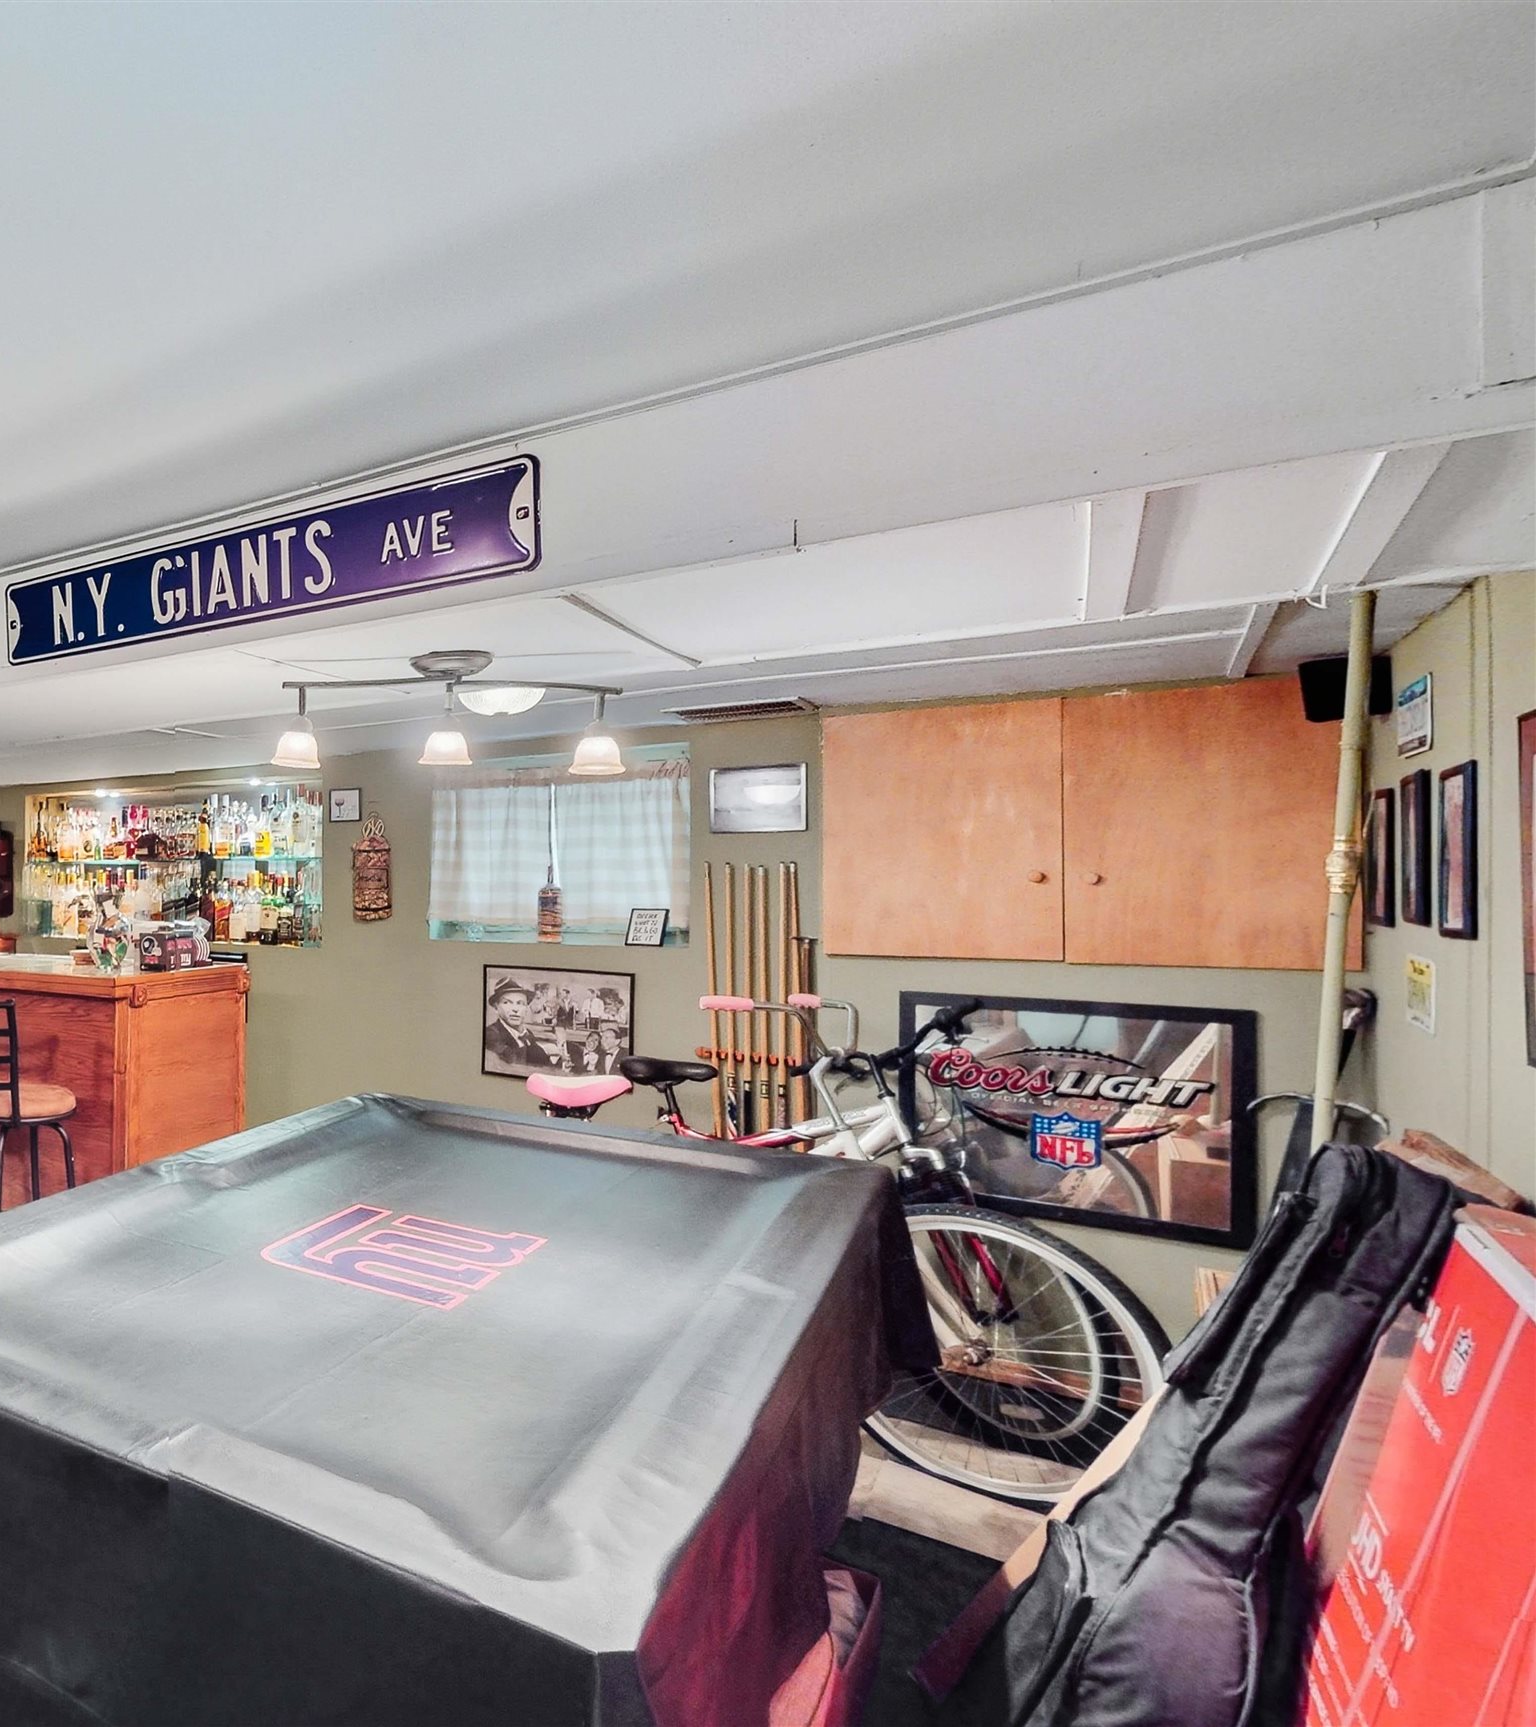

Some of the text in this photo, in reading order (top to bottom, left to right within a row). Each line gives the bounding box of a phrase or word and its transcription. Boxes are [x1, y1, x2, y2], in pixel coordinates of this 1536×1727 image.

[51, 509, 455, 646] N.Y. GIANTS AVE
[927, 1047, 1214, 1108] Coors LIGHT
[1036, 1134, 1096, 1167] NFL
